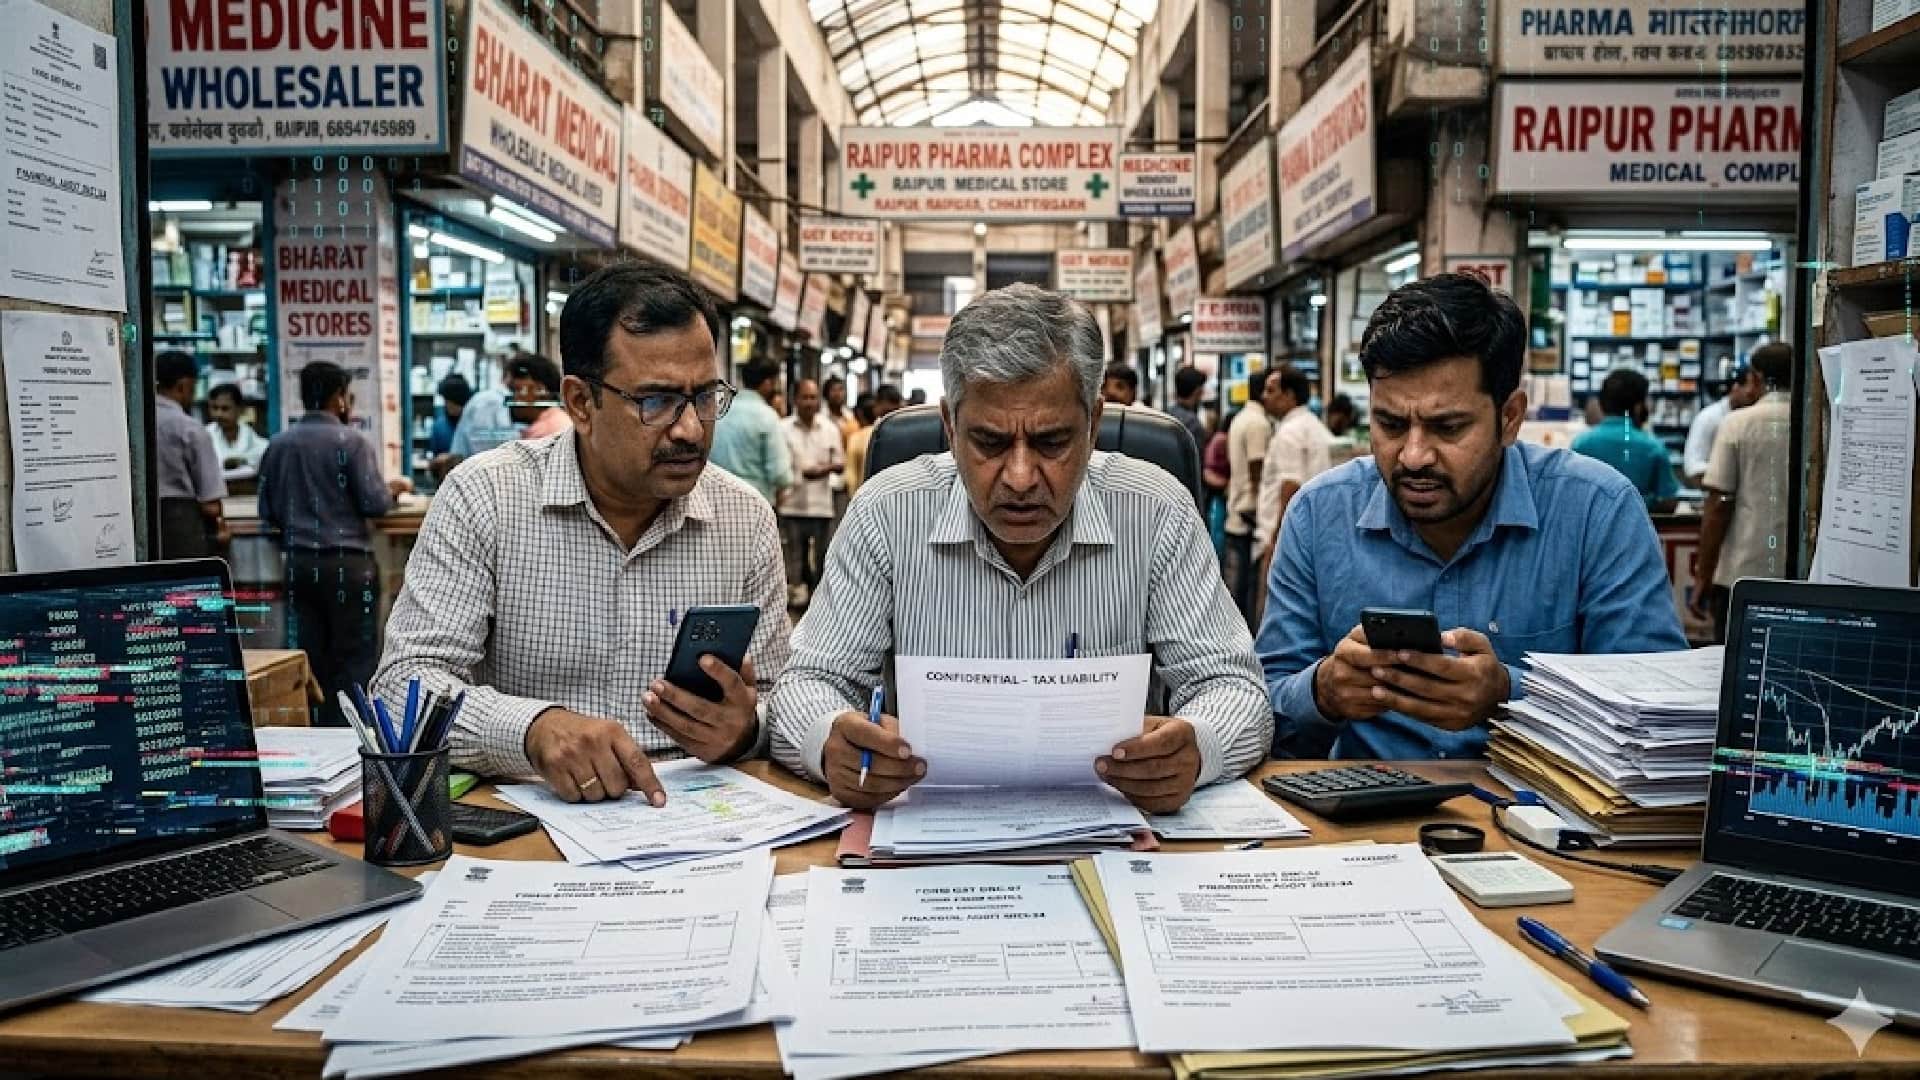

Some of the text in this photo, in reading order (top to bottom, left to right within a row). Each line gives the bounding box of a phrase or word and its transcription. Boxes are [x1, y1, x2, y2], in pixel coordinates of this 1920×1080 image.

[169, 0, 429, 51] MEDICINE
[1520, 8, 1634, 36] PHARMA
[161, 64, 425, 110] WHOLESALER
[474, 24, 618, 185] BHARAT MEDICAL
[1513, 105, 1656, 153] RAIPUR
[847, 141, 1114, 170] RAIPUR PHARMA COMPLEX
[1123, 157, 1193, 174] MEDICINE
[892, 177, 1069, 192] RAIPUR MEDICAL STORE
[1610, 162, 1706, 182] MEDICAL
[279, 245, 368, 271] BHARAT
[281, 279, 374, 305] MEDICAL
[288, 312, 372, 338] STORES
[926, 671, 1020, 686] CONFIDENTIAL
[1032, 674, 1057, 685] TAX
[1060, 671, 1120, 685] LIABILITY
